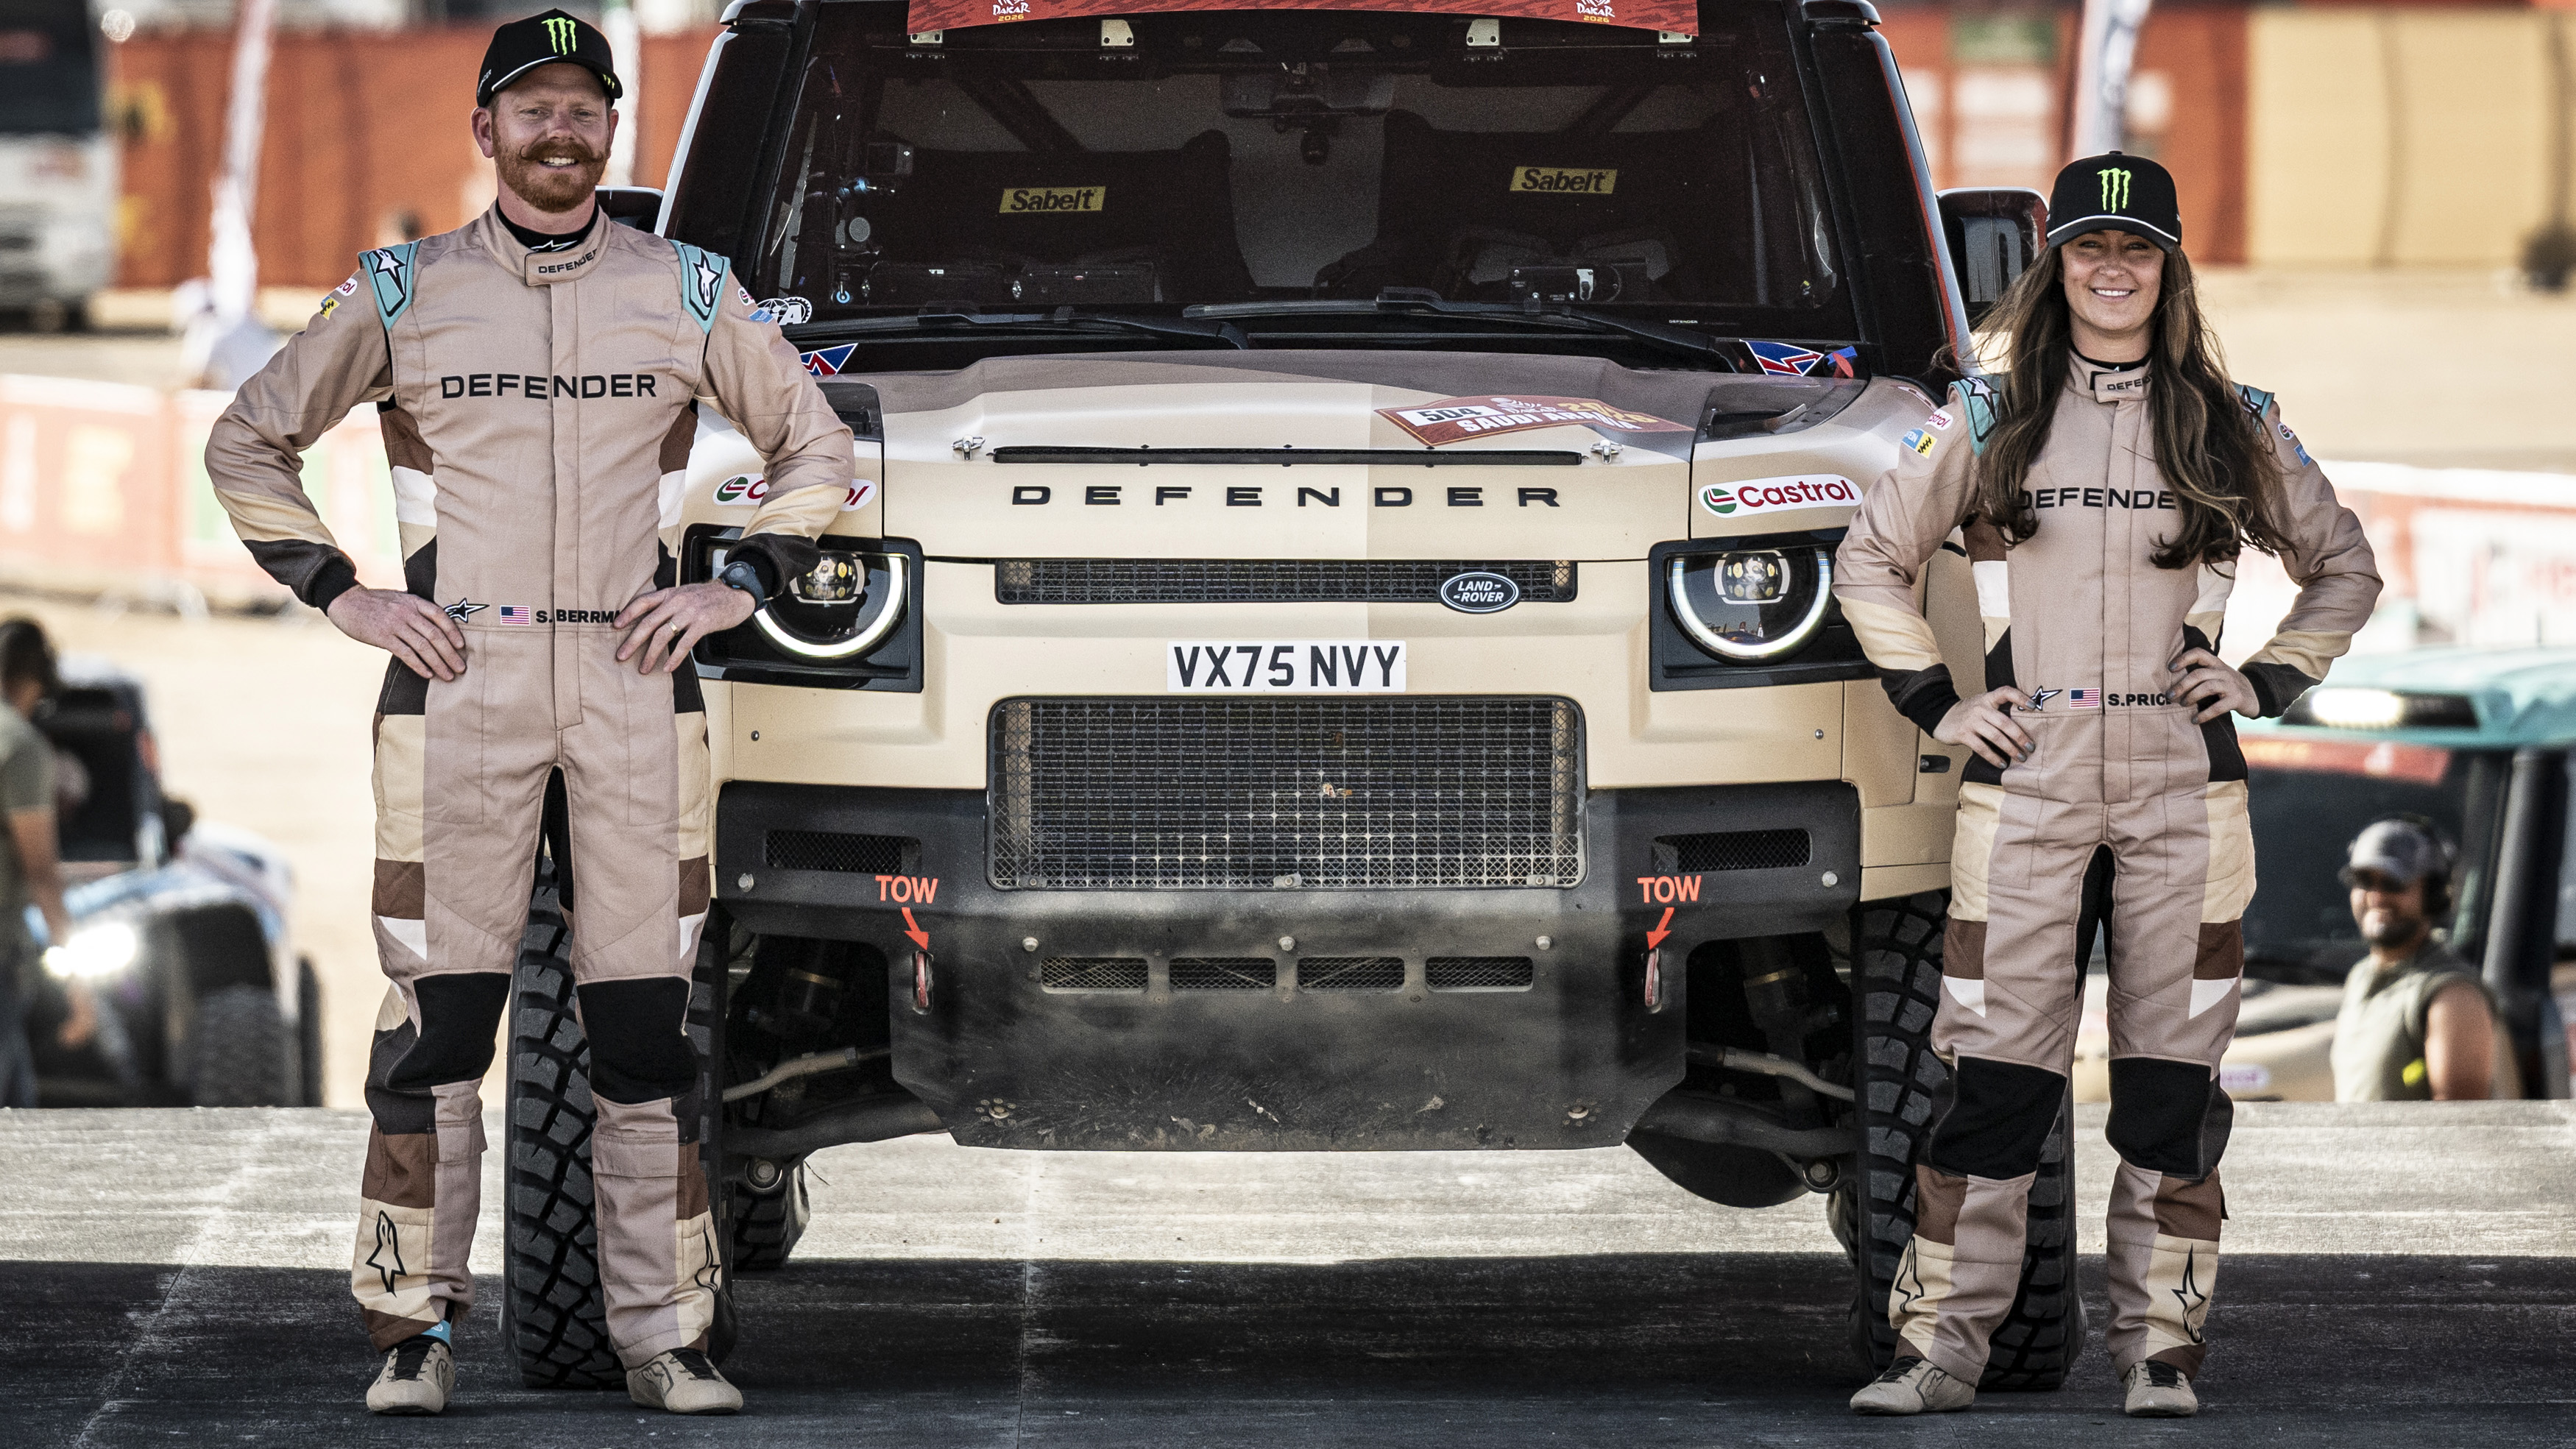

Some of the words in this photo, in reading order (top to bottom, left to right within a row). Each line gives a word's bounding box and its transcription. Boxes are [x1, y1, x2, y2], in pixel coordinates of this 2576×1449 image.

[992, 2, 1030, 15] DAKAR
[1576, 2, 1616, 18] DAKAR
[1521, 169, 1606, 191] Sabelt
[1011, 188, 1094, 210] Sabelt
[441, 373, 657, 400] DEFENDER
[1417, 408, 1482, 422] 504
[1457, 412, 1543, 433] SAUDI
[1542, 411, 1643, 430] ARABIA
[1011, 485, 1561, 508] DEFENDER
[1738, 479, 1855, 508] Castrol
[2020, 487, 2177, 511] DEFENDE
[1174, 645, 1294, 687] VX75
[1310, 645, 1400, 687] NVY
[875, 875, 938, 904] TOW
[1638, 875, 1702, 903] TOW
